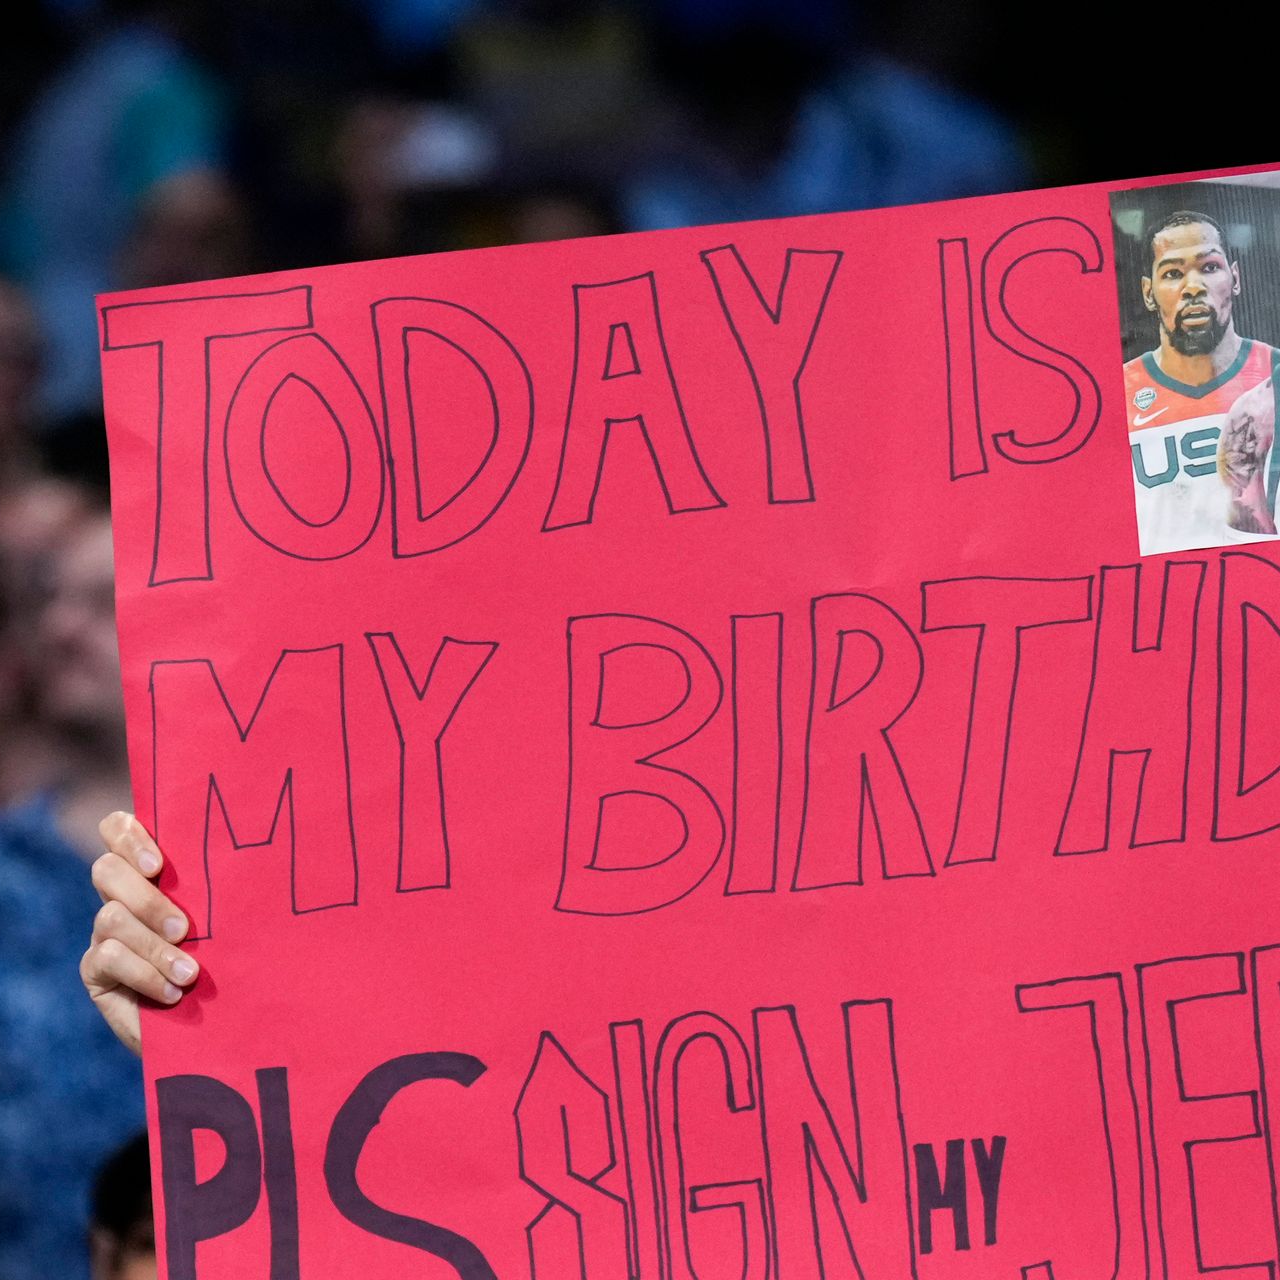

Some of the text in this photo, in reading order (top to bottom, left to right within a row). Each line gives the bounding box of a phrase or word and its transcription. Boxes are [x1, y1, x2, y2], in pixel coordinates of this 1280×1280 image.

[102, 216, 1104, 588] TODAY IS
[148, 630, 499, 943] MY
[914, 1135, 1007, 1255] MY
